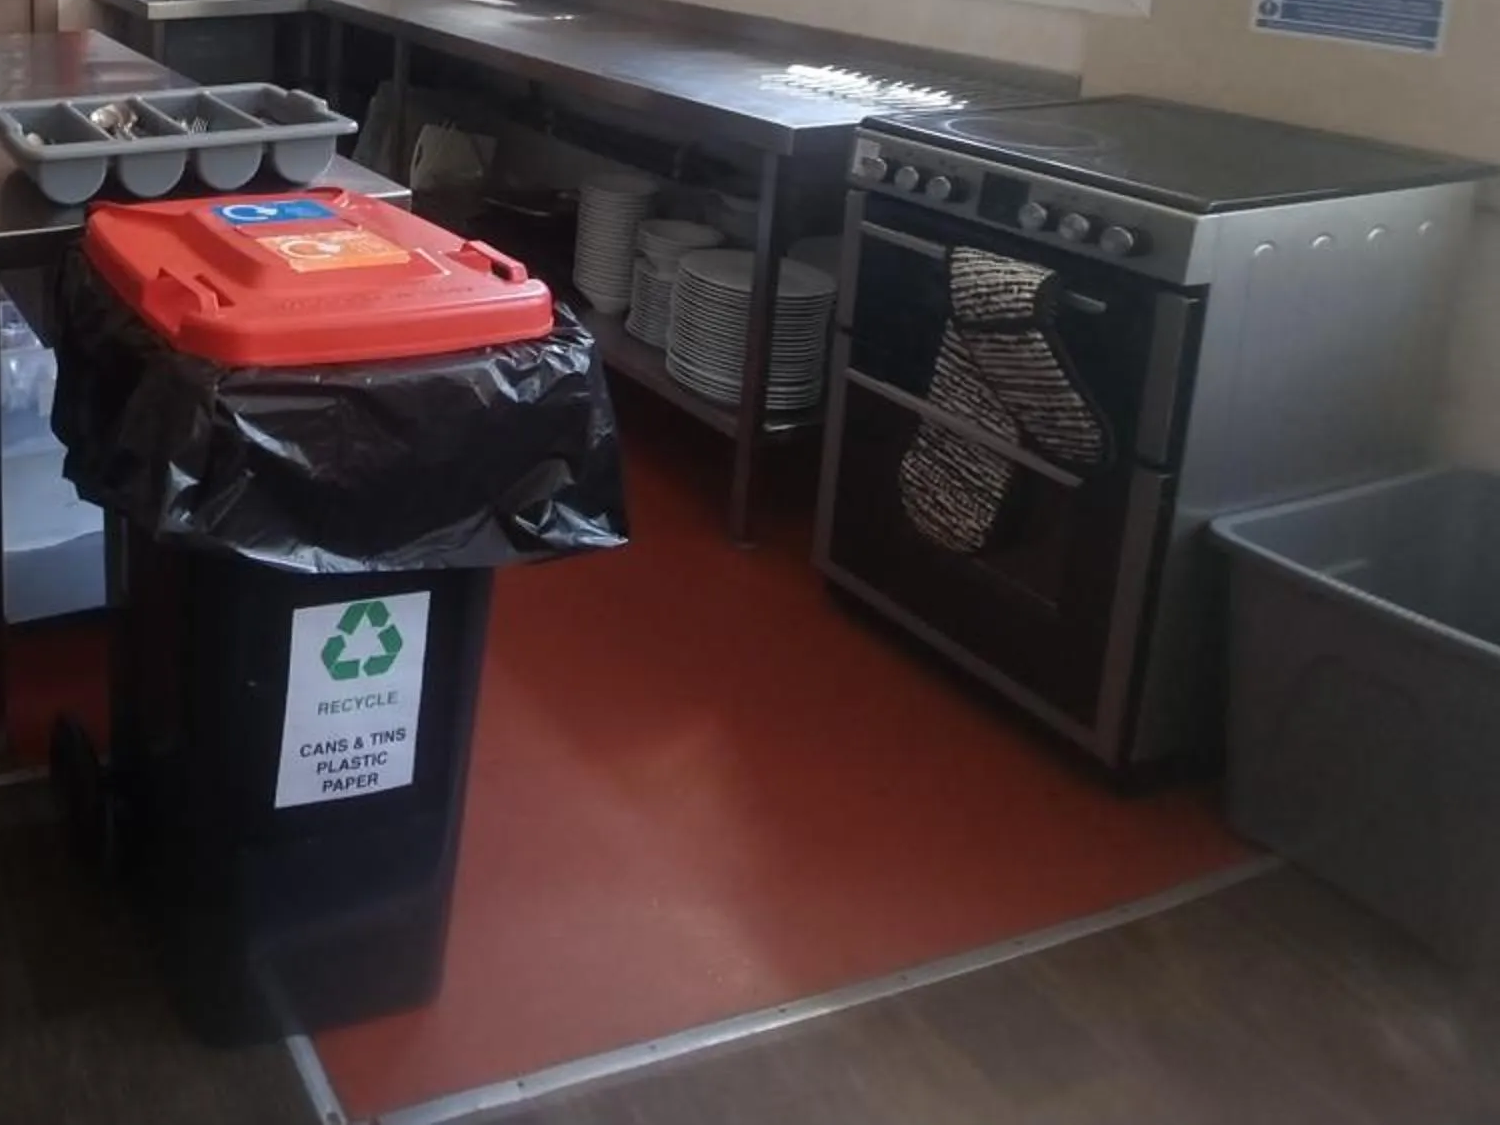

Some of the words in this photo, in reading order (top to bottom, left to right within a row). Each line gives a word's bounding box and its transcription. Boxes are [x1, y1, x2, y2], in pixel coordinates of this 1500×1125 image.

[317, 690, 398, 716] RECYCLE
[299, 738, 349, 758] CANS
[353, 736, 364, 751] &
[370, 727, 407, 746] TINS
[316, 750, 389, 775] PLASTIC
[322, 773, 379, 794] PAPER
